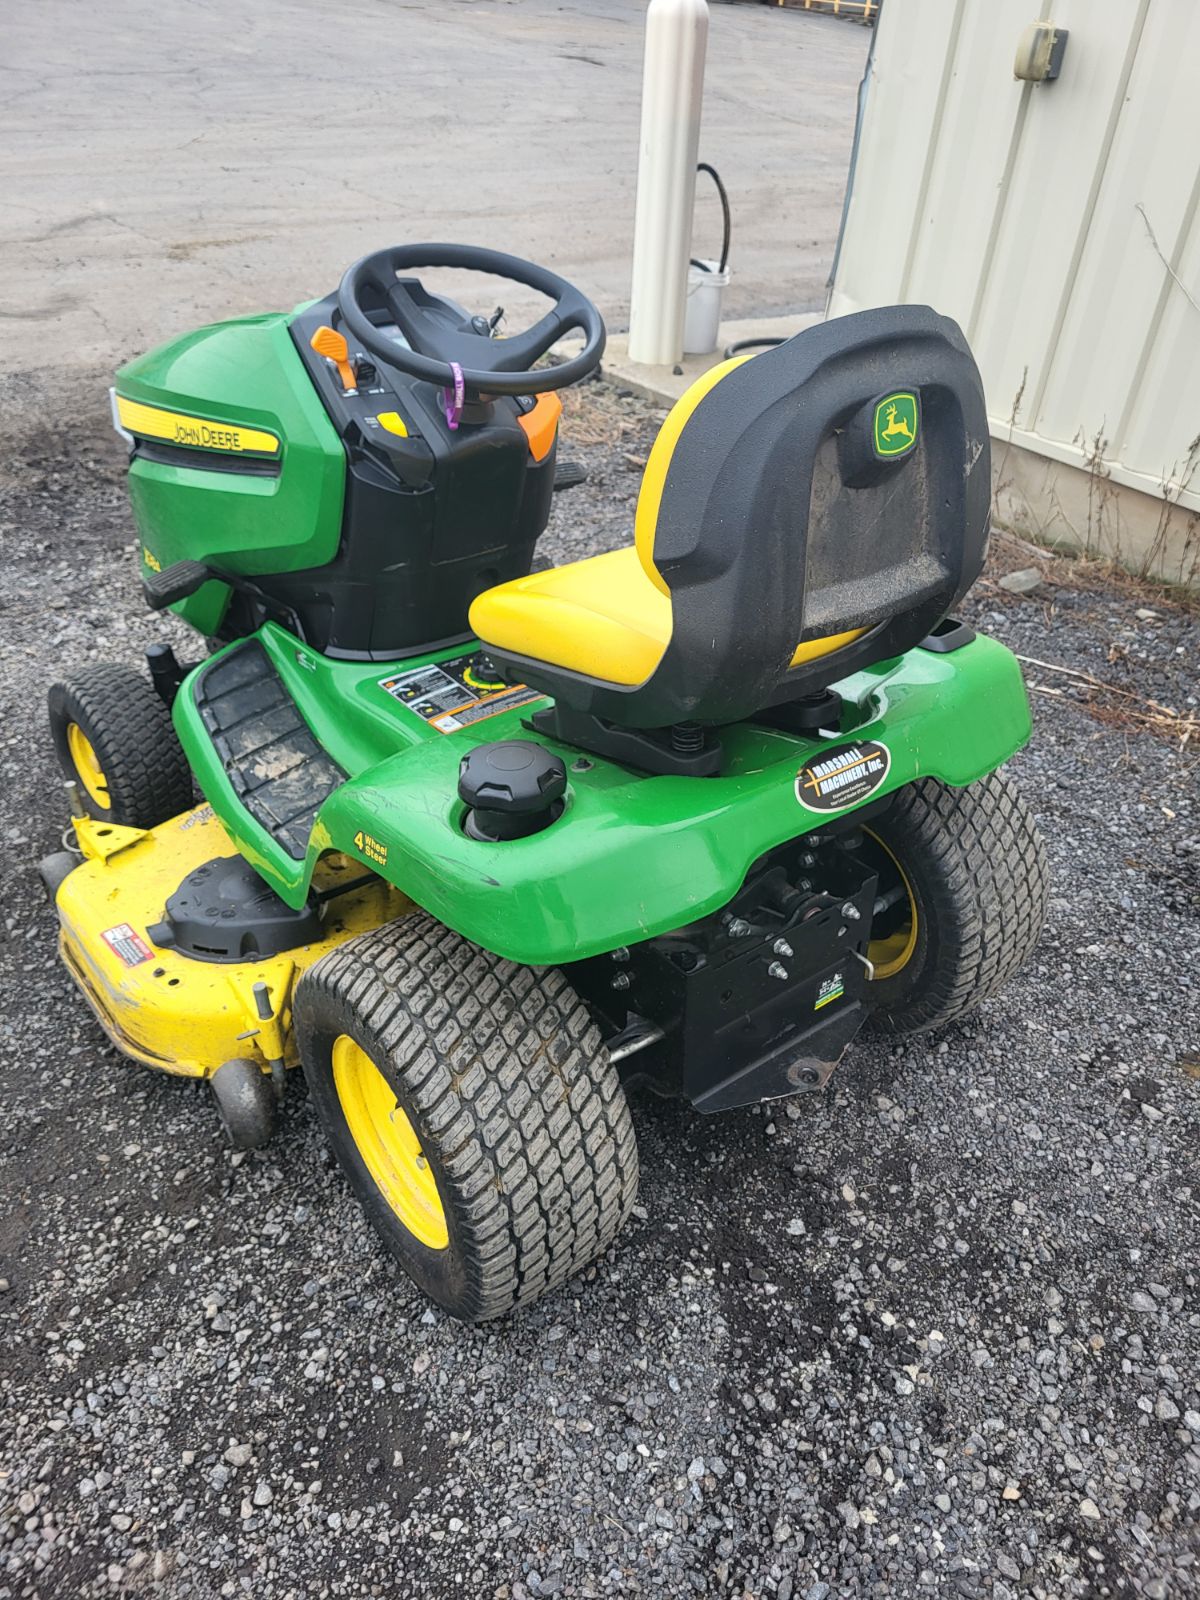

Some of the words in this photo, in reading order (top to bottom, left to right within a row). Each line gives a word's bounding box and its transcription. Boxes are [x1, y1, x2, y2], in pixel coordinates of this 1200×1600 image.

[174, 422, 200, 443] JOHN
[202, 426, 241, 448] DEERE
[812, 746, 864, 778] MARSHALL
[820, 763, 869, 795] MACHINERY,
[867, 758, 884, 773] Inc.
[354, 831, 364, 850] 4
[365, 834, 387, 857] Wheel
[365, 845, 386, 867] Steer
